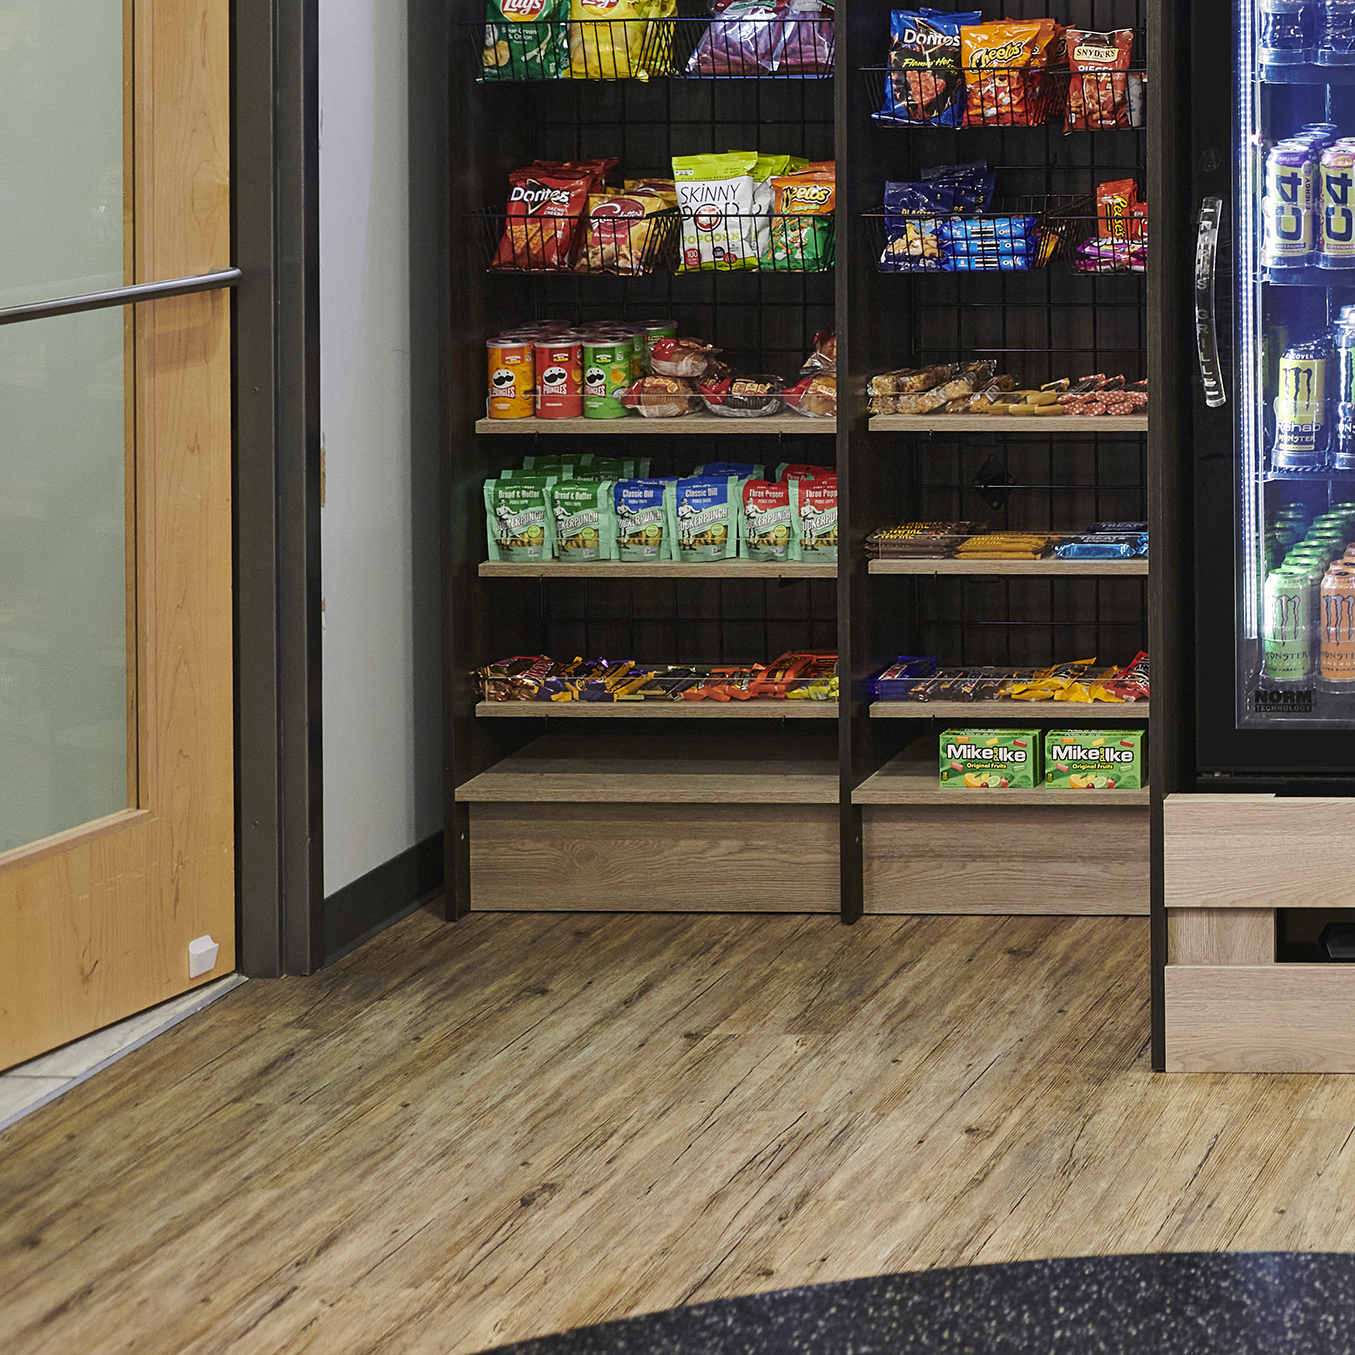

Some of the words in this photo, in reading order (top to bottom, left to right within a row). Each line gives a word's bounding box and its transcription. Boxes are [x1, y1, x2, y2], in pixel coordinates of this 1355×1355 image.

[904, 29, 960, 46] Doritos
[970, 41, 1023, 72] Cheetos
[510, 186, 570, 204] Doritos
[1325, 172, 1353, 242] C4
[543, 384, 567, 395] PRINGLES
[622, 490, 641, 498] Classic
[685, 488, 706, 497] Classic
[708, 488, 717, 496] Dill
[749, 489, 763, 497] Three
[765, 490, 783, 498] Pepper
[1255, 691, 1312, 703] NORM
[947, 744, 993, 760] Mike
[999, 747, 1027, 763] Ike
[1052, 745, 1100, 761] Mike
[1105, 747, 1133, 763] Ike
[966, 762, 990, 770] Original
